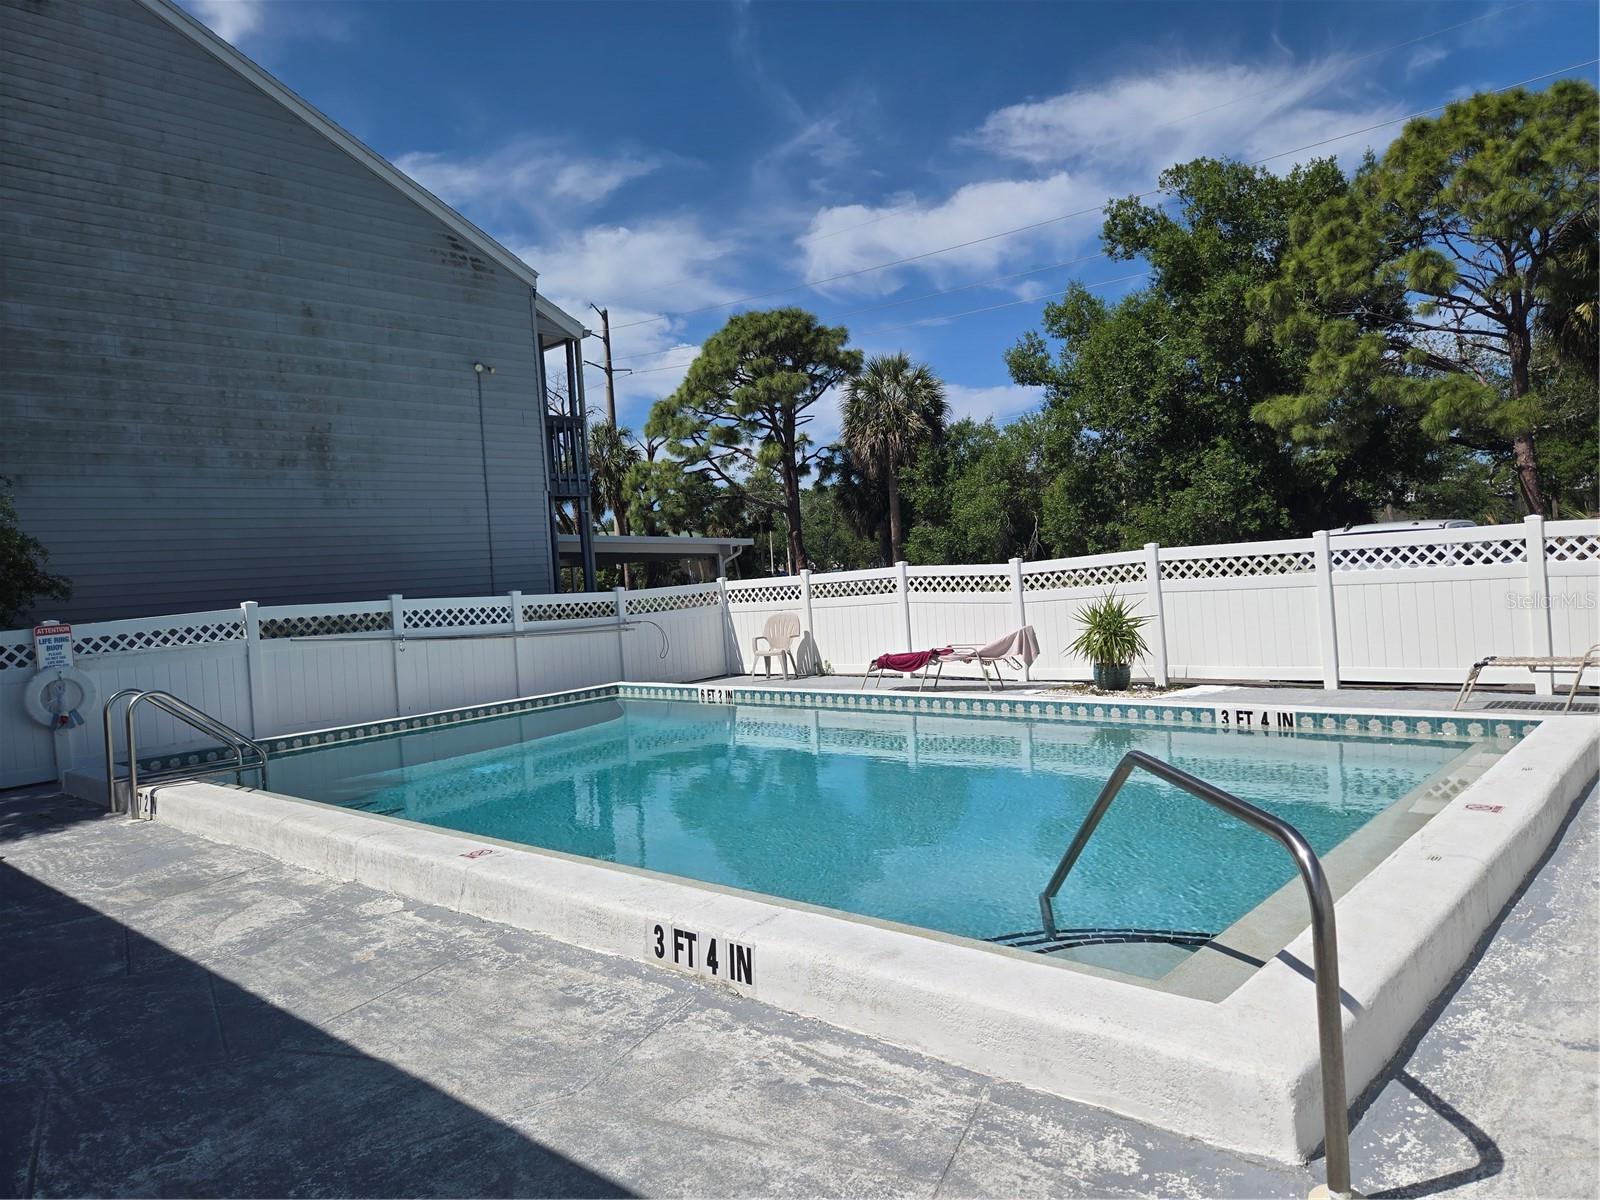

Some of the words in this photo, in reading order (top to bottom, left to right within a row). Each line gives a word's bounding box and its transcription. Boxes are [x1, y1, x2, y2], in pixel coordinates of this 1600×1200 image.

[1221, 709, 1229, 724] 3
[1236, 710, 1253, 725] FT
[1261, 711, 1270, 726] 4
[1277, 712, 1294, 728] IN
[653, 924, 665, 959] 3
[673, 928, 697, 968] FT
[706, 938, 719, 976] 4
[729, 943, 753, 986] IN
